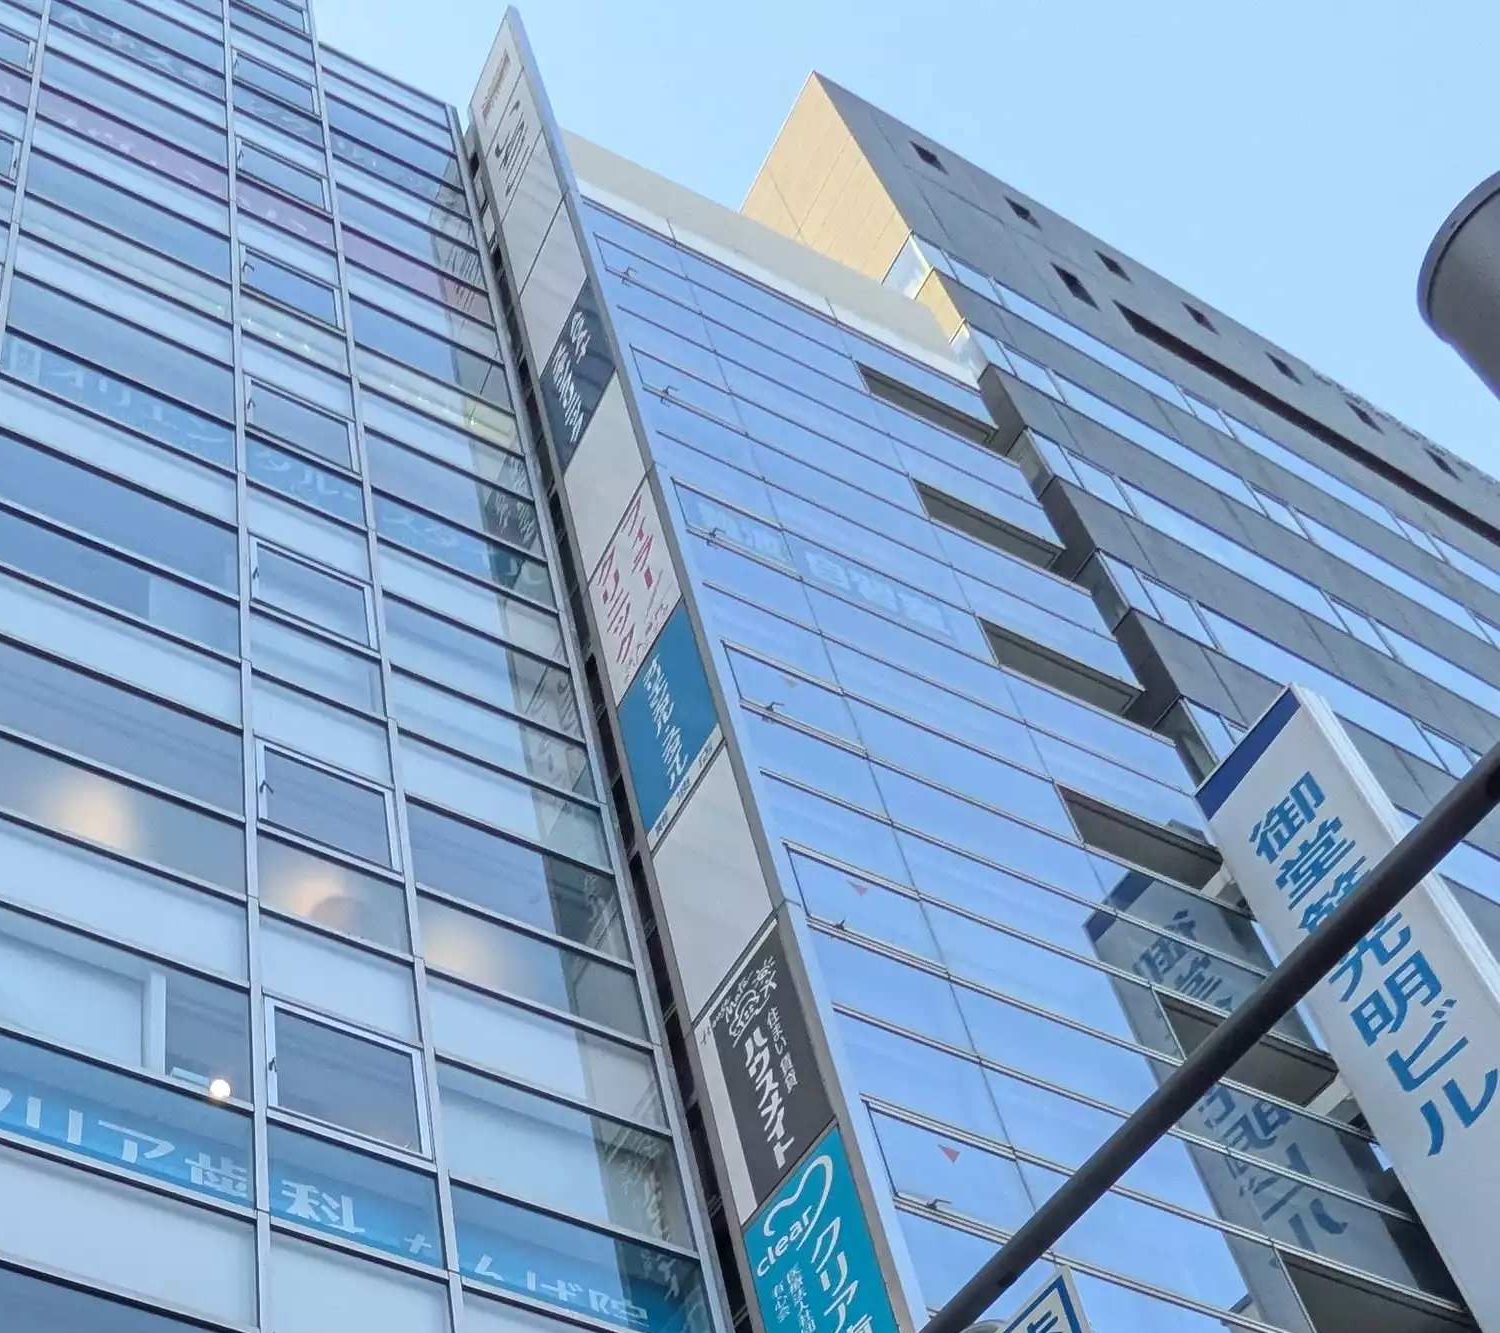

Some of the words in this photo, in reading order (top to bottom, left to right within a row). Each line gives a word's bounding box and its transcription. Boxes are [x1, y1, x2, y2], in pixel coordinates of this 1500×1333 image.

[745, 1027, 795, 1170] ハウスメイト
[756, 1205, 815, 1278] clear
